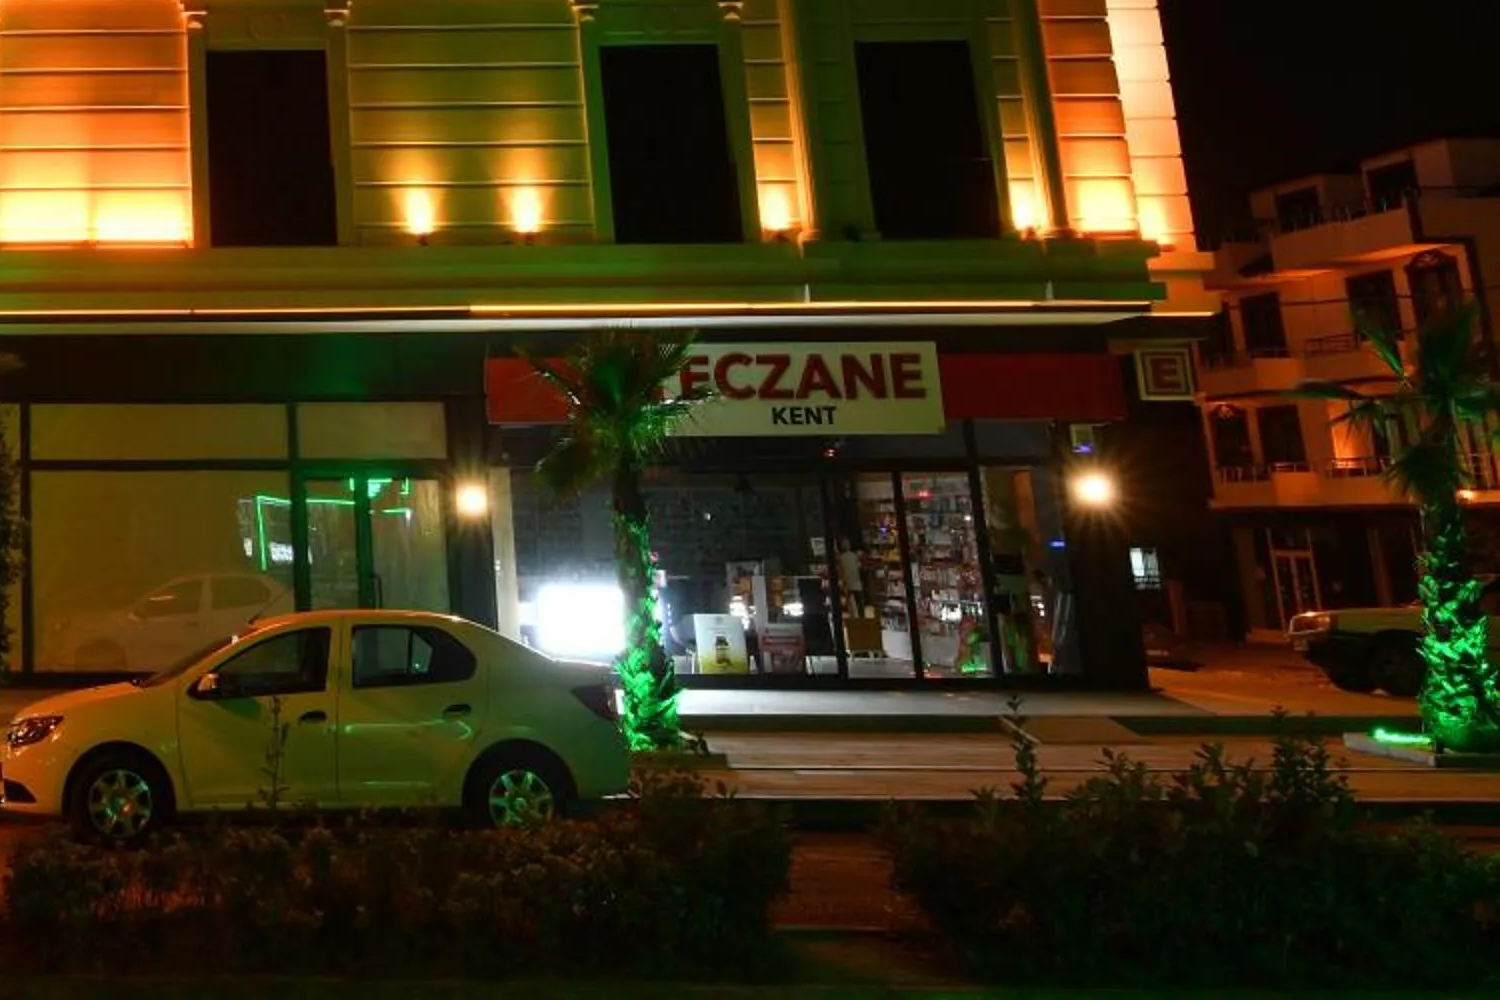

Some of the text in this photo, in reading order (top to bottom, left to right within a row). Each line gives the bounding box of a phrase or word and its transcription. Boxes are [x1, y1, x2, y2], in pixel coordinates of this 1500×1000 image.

[678, 352, 928, 400] ECZANE
[1150, 358, 1181, 389] E
[771, 406, 837, 426] KENT
